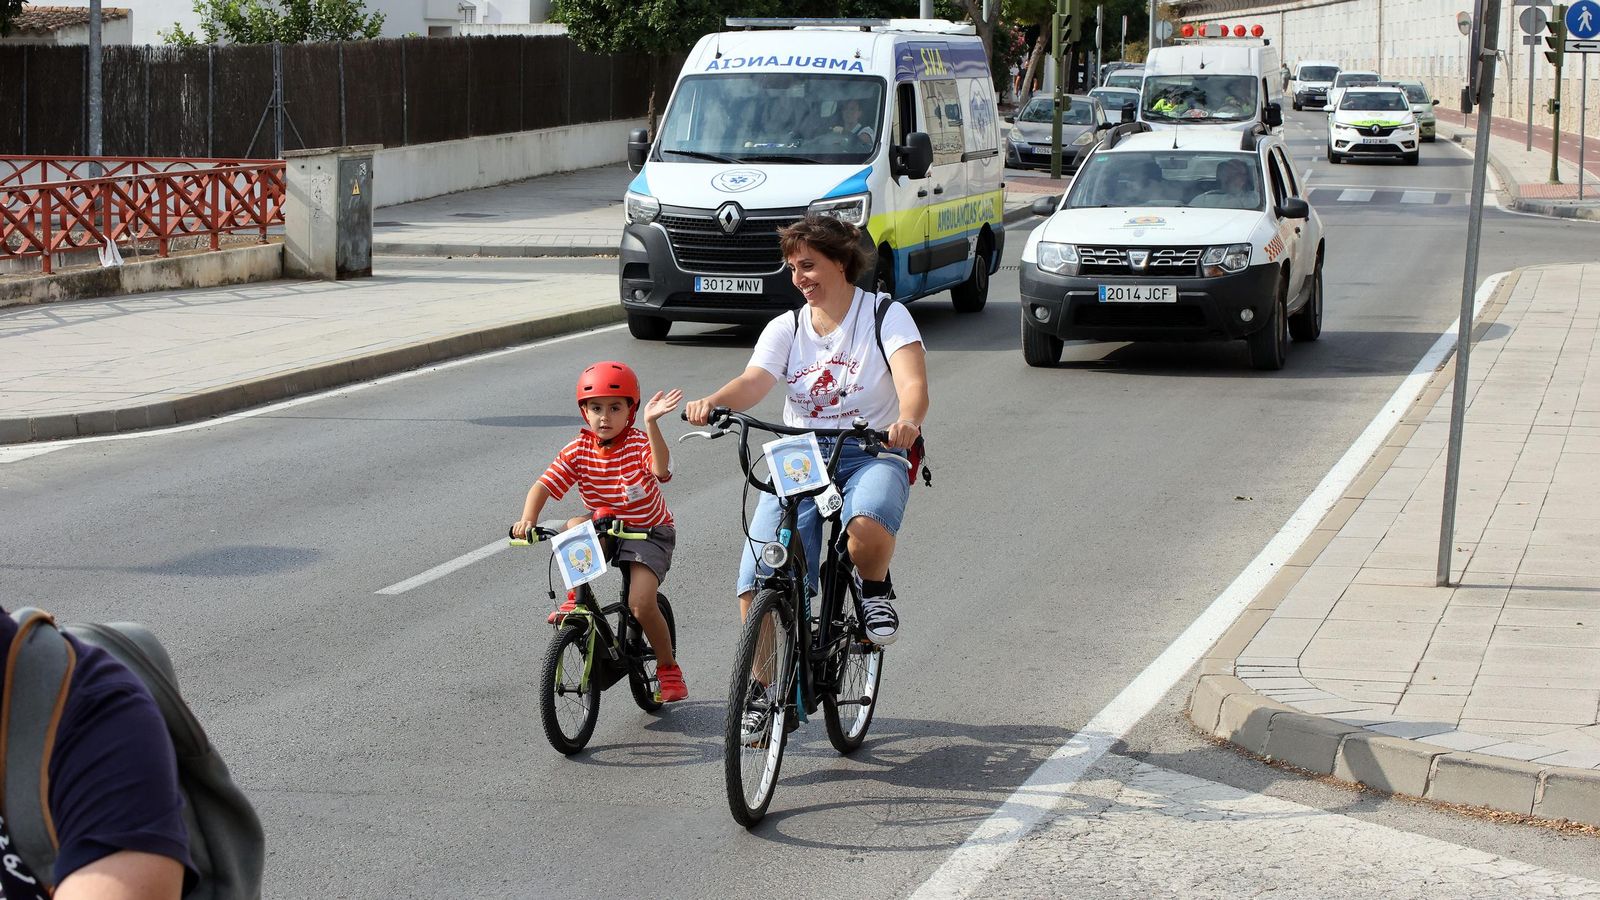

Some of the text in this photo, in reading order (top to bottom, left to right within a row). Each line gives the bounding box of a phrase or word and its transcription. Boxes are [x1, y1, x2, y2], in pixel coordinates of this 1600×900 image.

[920, 48, 948, 76] S.V.A.
[703, 278, 760, 292] 3012 MNV
[1107, 287, 1170, 300] 2014 JCF
